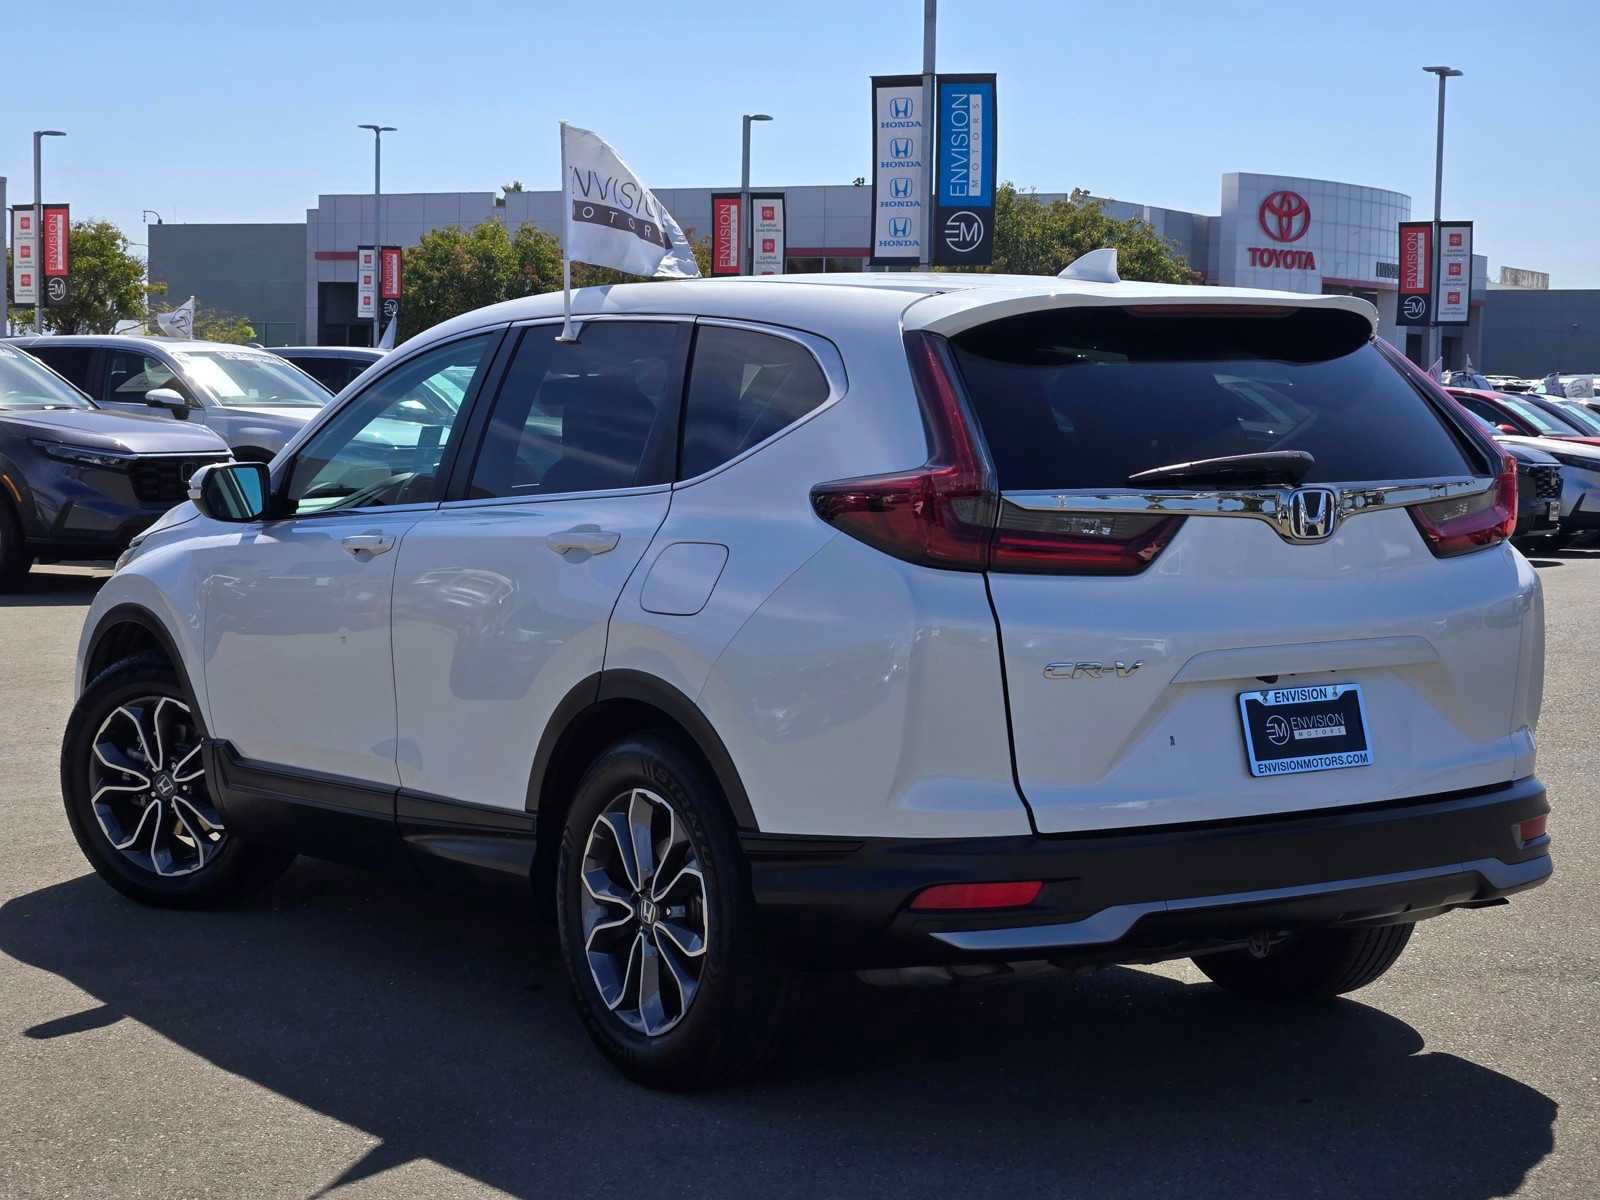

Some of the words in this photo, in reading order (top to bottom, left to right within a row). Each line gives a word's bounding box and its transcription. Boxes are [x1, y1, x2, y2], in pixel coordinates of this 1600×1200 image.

[950, 94, 968, 197] ENVISION
[971, 103, 979, 188] MOTORS
[569, 165, 664, 228] NVISIO
[880, 200, 921, 208] HONDA
[572, 206, 664, 243] OTOR
[720, 204, 731, 267] ENVISION
[49, 214, 57, 270] ENVISION
[879, 239, 920, 247] HONDA
[1248, 247, 1316, 271] TOYOTA
[1407, 232, 1417, 289] ENVISION
[1042, 660, 1145, 680] CR-V
[1274, 688, 1328, 703] ENVISION
[1290, 712, 1345, 730] ENVISION
[1298, 728, 1342, 737] MOTORS
[1257, 753, 1369, 774] ENVISIONMOTORS.COM
